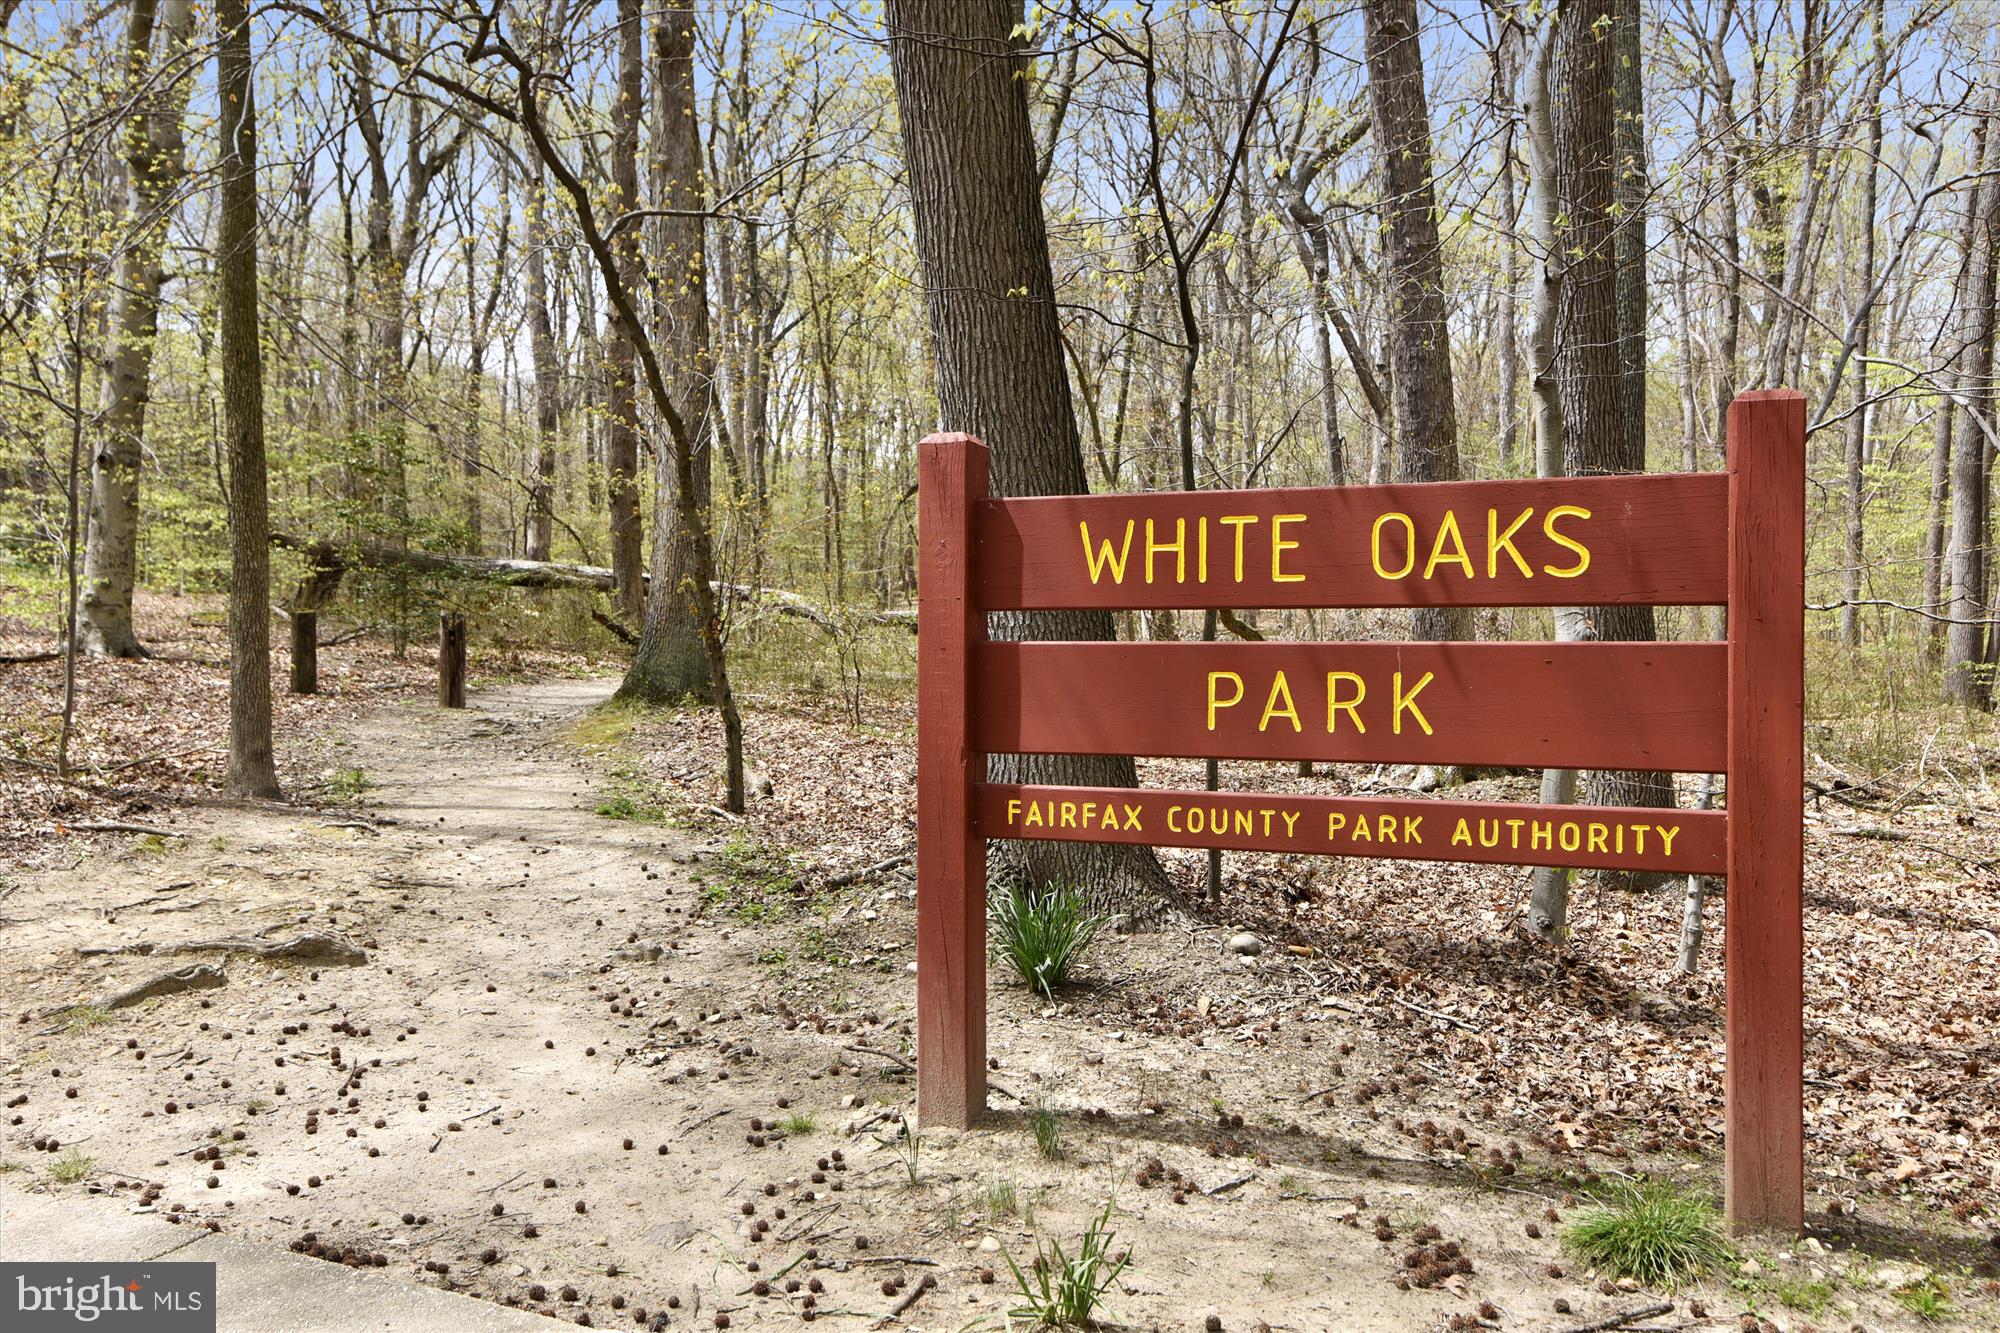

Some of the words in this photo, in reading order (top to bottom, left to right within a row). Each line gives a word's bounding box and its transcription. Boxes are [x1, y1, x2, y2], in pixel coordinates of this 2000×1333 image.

[1079, 513, 1308, 584] WHITE
[1371, 504, 1592, 581] OAKS
[1207, 670, 1435, 736] PARK
[1007, 799, 1143, 831] FAIRFAX
[1167, 805, 1301, 838] COUNTY
[1328, 812, 1423, 844] PARK
[1451, 817, 1681, 857] AUTHORITY
